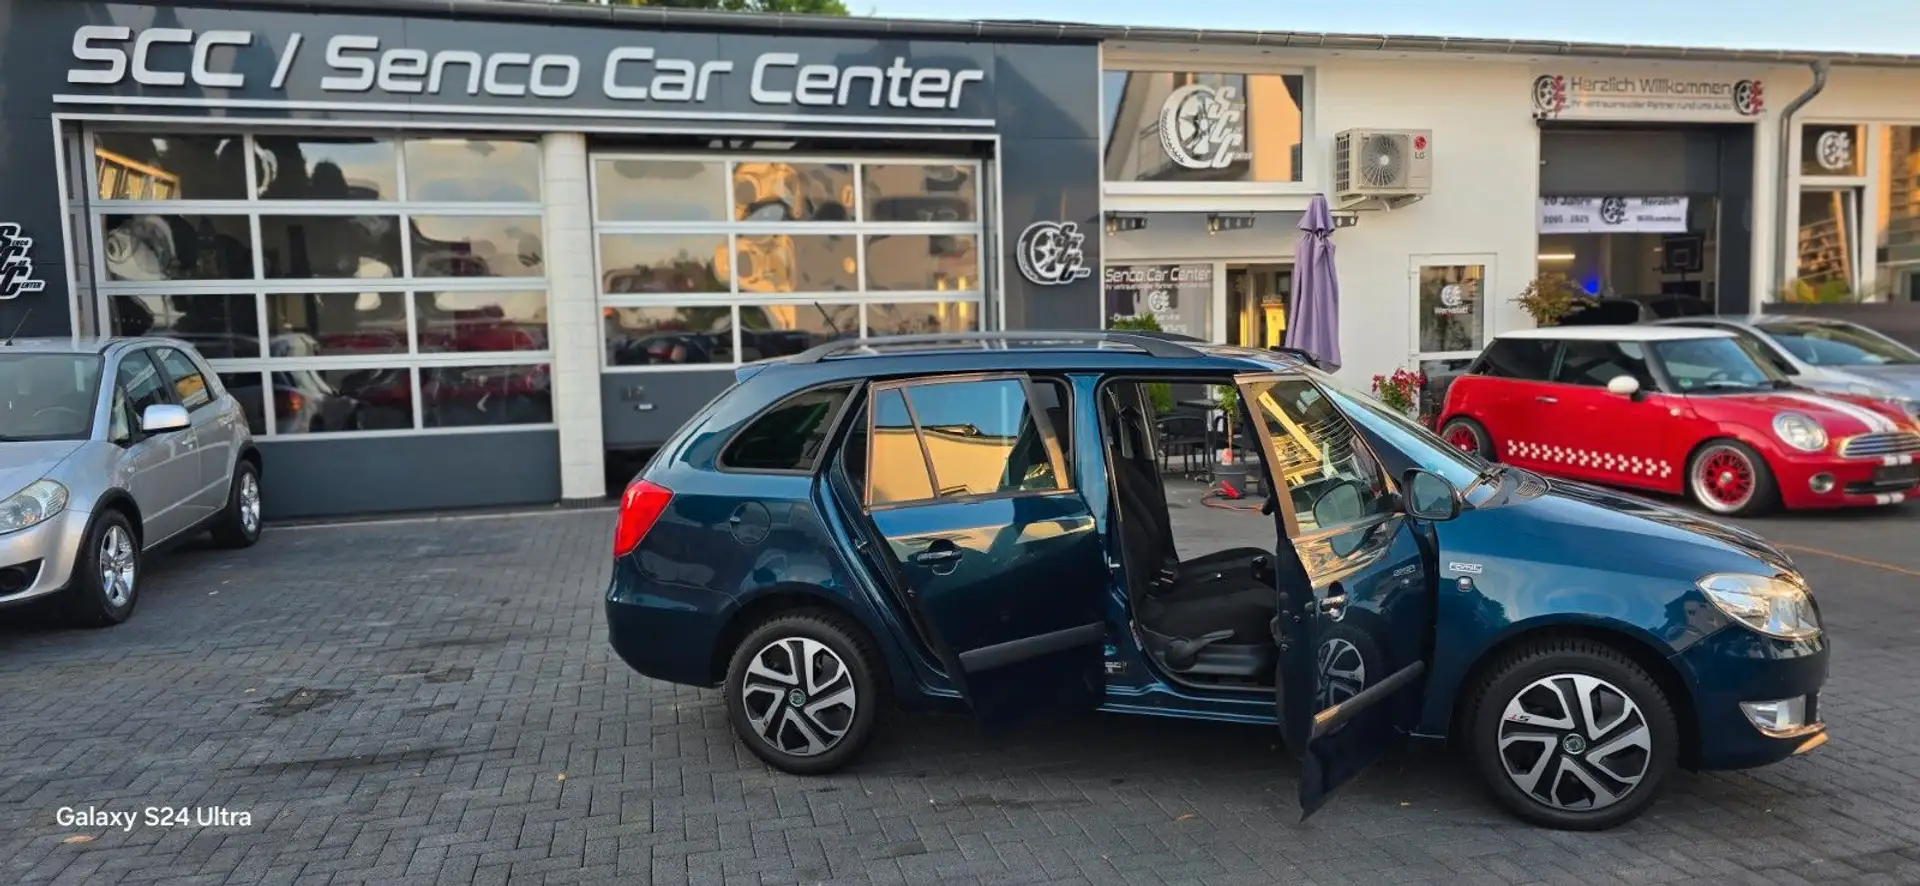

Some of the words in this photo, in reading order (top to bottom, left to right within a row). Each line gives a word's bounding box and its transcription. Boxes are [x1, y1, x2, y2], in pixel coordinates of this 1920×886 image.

[67, 25, 252, 88] SCC
[270, 33, 302, 88] /
[320, 34, 580, 98] Senco
[603, 46, 734, 102] Car
[750, 52, 984, 109] Center
[1571, 77, 1636, 93] Herzlich
[1640, 78, 1732, 95] Willkommen
[1414, 151, 1426, 160] LG
[1105, 267, 1144, 282] Senco
[1146, 267, 1168, 281] Car
[1170, 267, 1211, 282] Center
